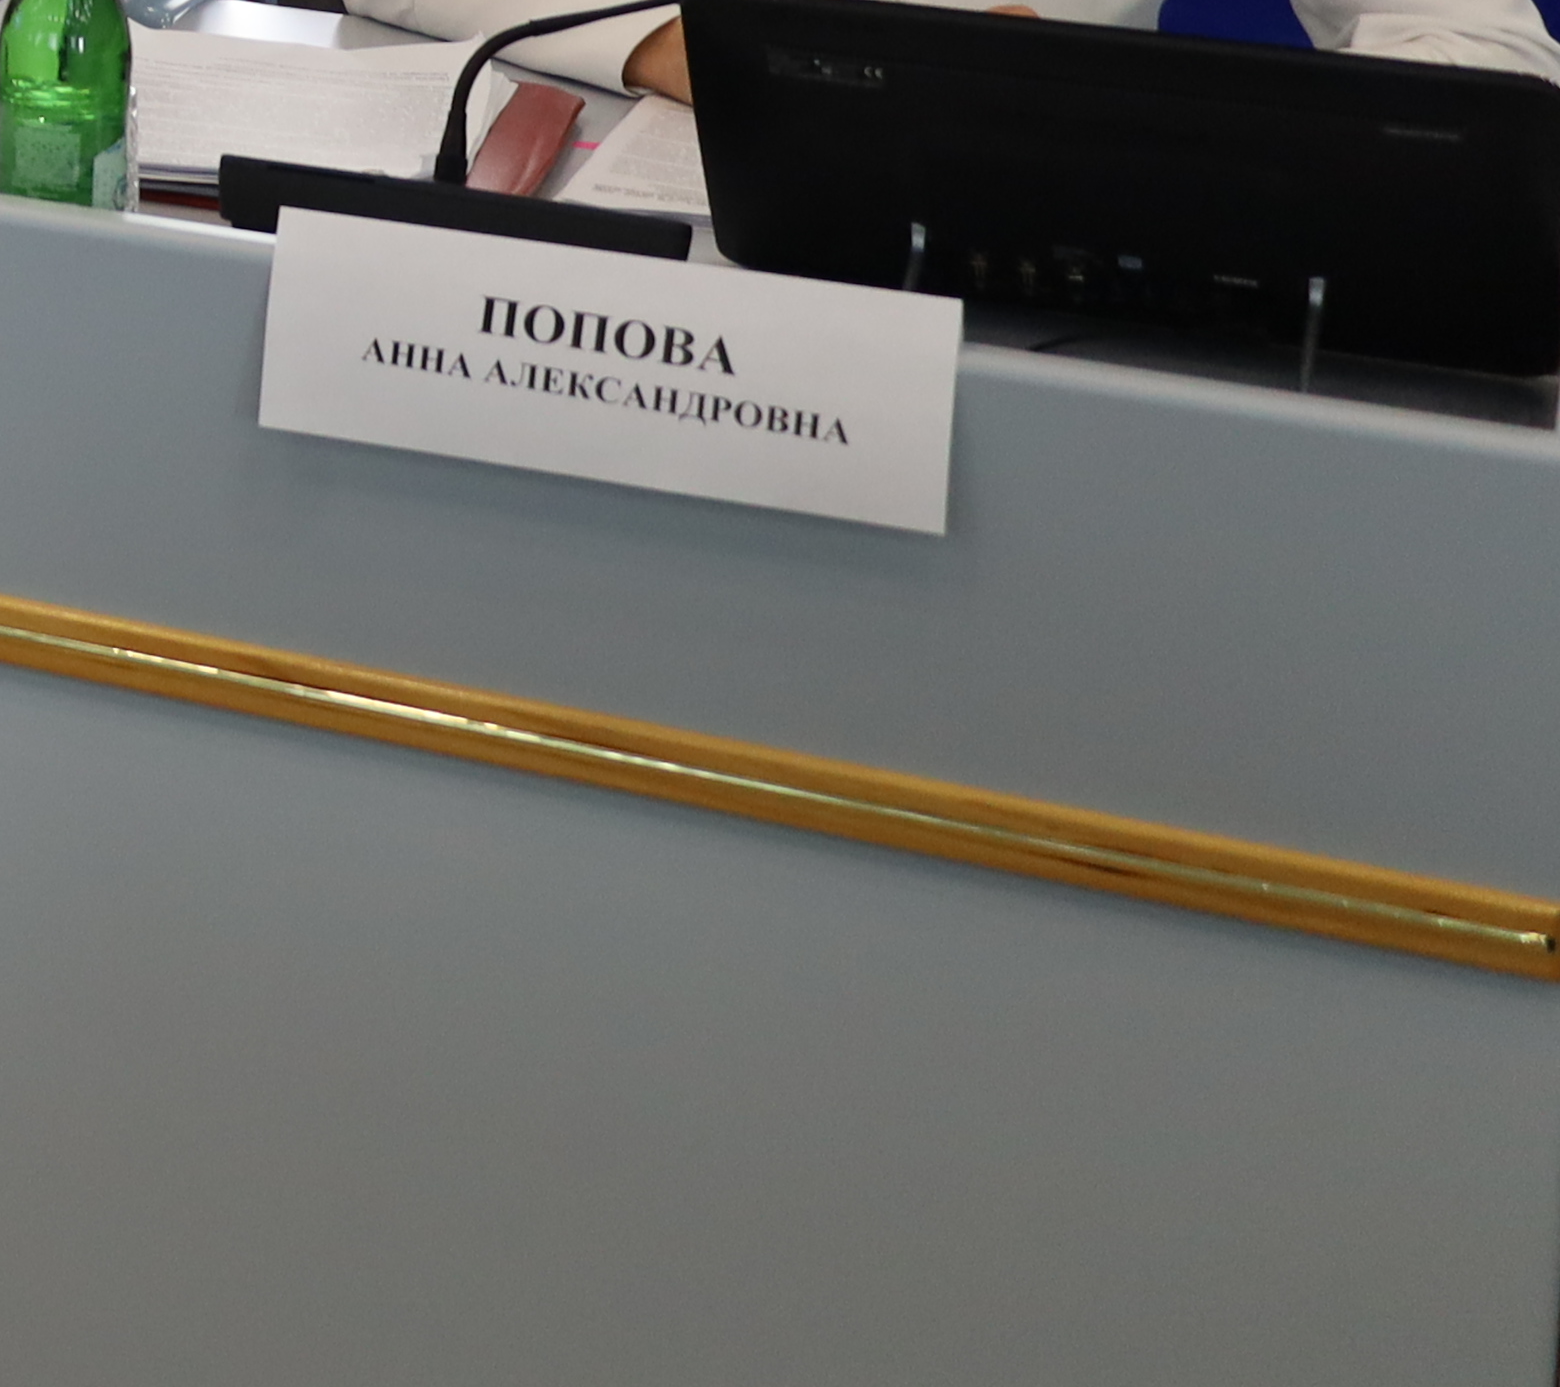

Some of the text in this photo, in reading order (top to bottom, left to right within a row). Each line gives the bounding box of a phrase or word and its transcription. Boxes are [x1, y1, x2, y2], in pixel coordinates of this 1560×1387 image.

[479, 295, 736, 376] ПОПОВА
[361, 337, 851, 445] АННА АЛЕКСАНДРОВНА
